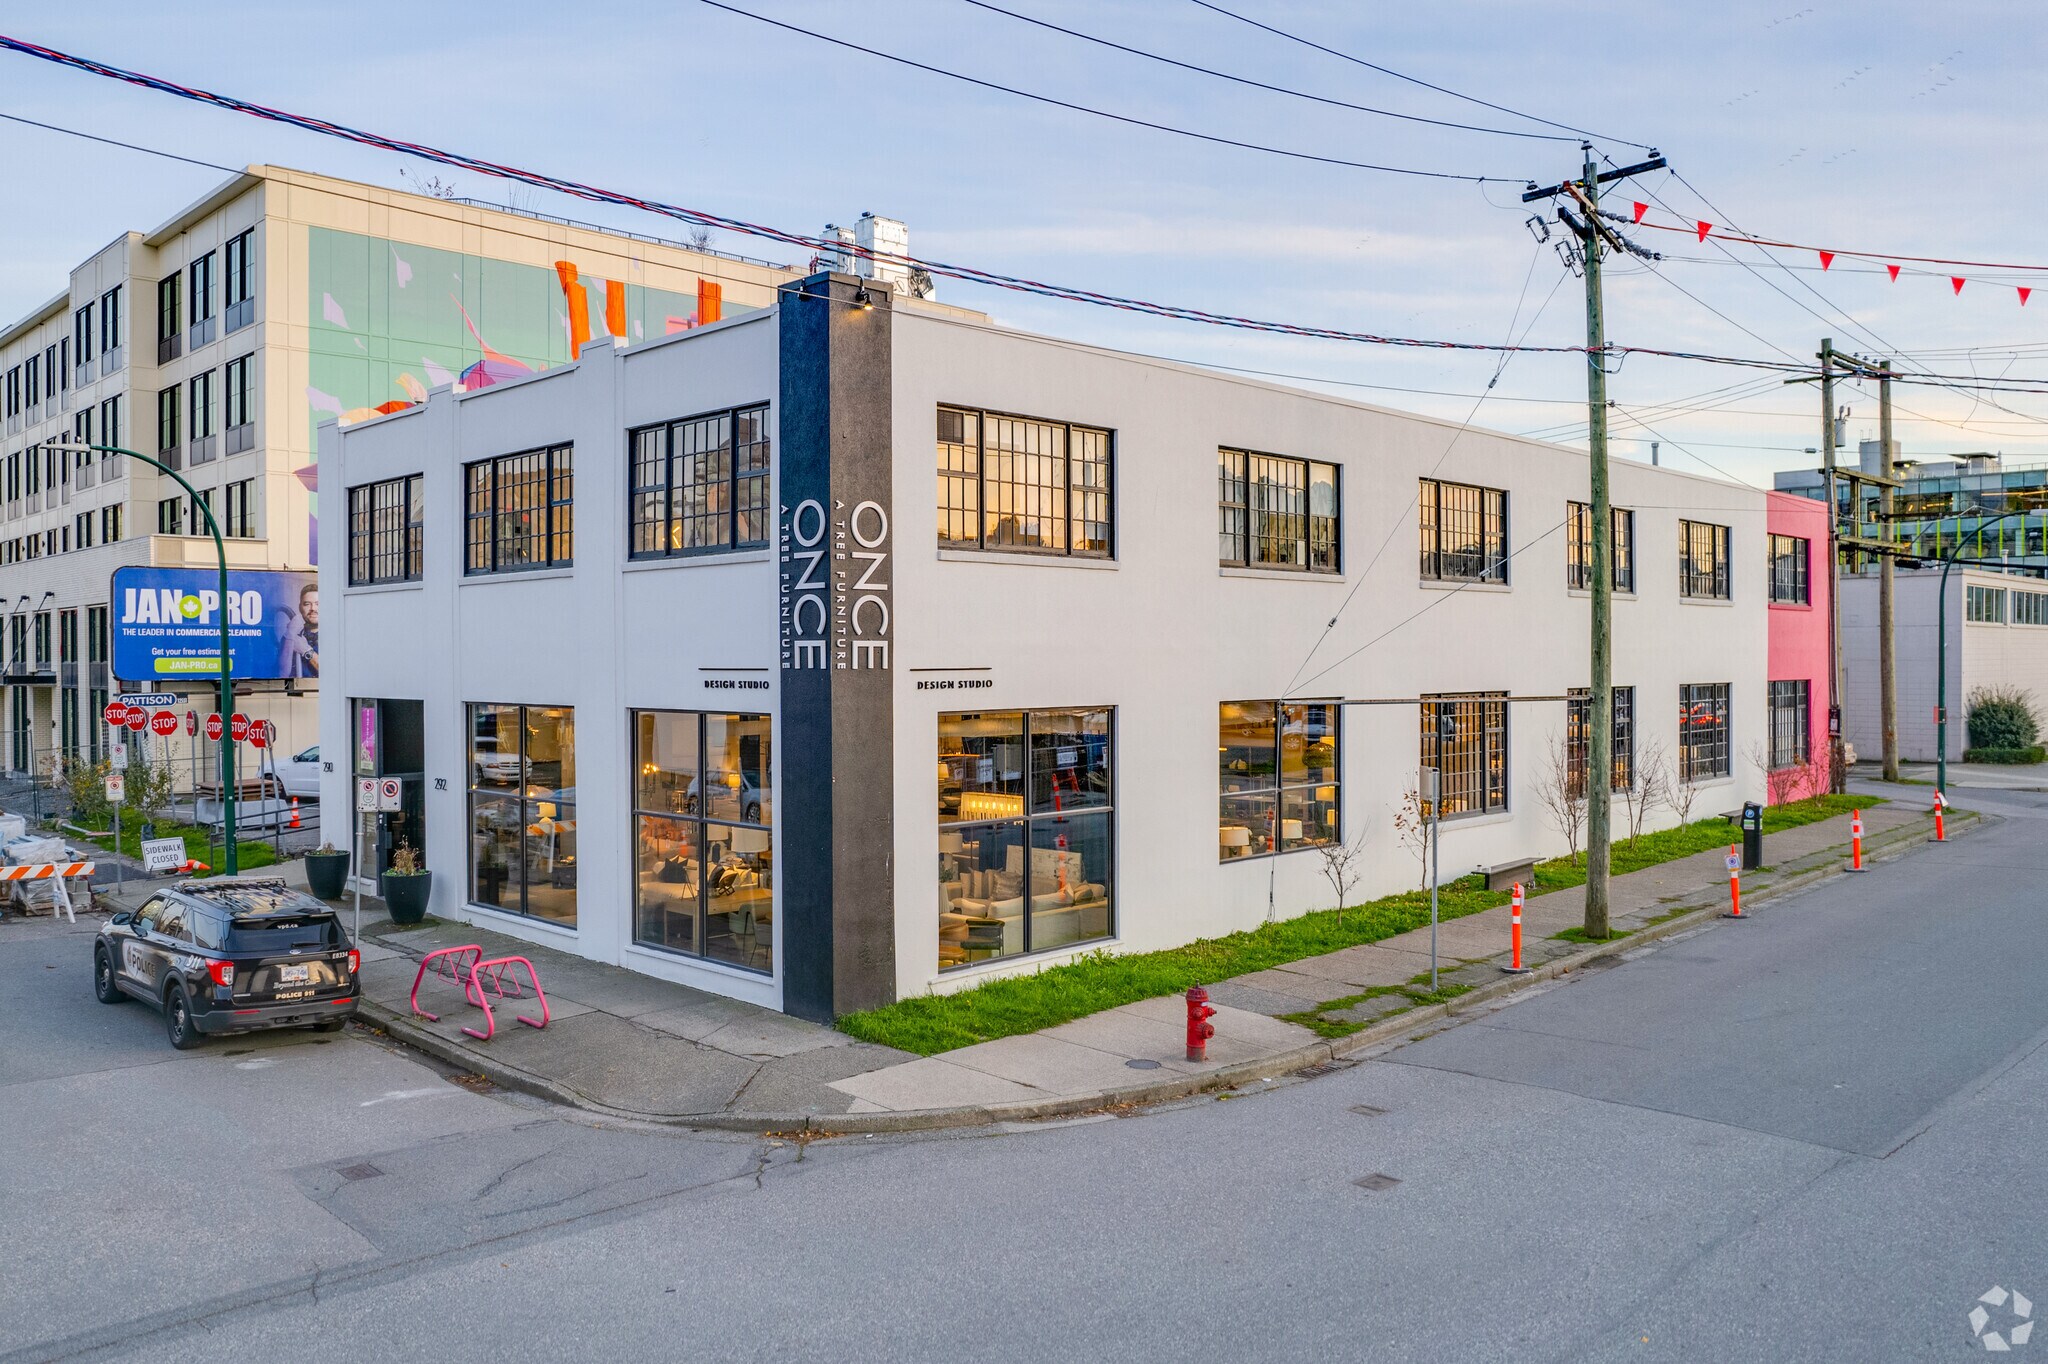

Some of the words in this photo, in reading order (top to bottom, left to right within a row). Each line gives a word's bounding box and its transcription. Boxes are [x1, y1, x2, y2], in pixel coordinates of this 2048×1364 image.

[781, 505, 790, 514] A
[835, 500, 845, 510] A
[781, 523, 790, 563] TREE
[835, 520, 846, 561] TREE
[793, 499, 827, 669] ONCE
[851, 500, 889, 669] ONCE
[781, 573, 790, 669] FURNITURE
[836, 571, 846, 669] FURNITURE
[122, 628, 136, 636] THE
[138, 628, 165, 636] LEADER
[166, 628, 174, 636] IN
[175, 628, 221, 637] COMMERCIA
[151, 647, 164, 656] Get
[165, 649, 181, 657] your
[182, 647, 196, 656] free
[197, 647, 221, 656] estima
[169, 661, 218, 670] JAN-PRO.ca
[704, 680, 736, 689] DESIGN
[737, 680, 770, 690] STUDIO
[917, 680, 955, 690] DESIGN
[957, 679, 993, 689] STUDIO
[122, 695, 173, 706] PATTISON
[106, 709, 127, 719] STOP
[126, 713, 144, 725] STOP
[152, 717, 176, 730] STOP
[207, 721, 222, 733] STOP
[249, 728, 265, 740] STO
[434, 778, 447, 791] 292
[145, 843, 182, 855] SIDEWALK
[152, 854, 179, 864] CLOSED
[132, 953, 156, 979] POLICE
[186, 954, 202, 970] 911
[275, 991, 303, 1000] POLICE
